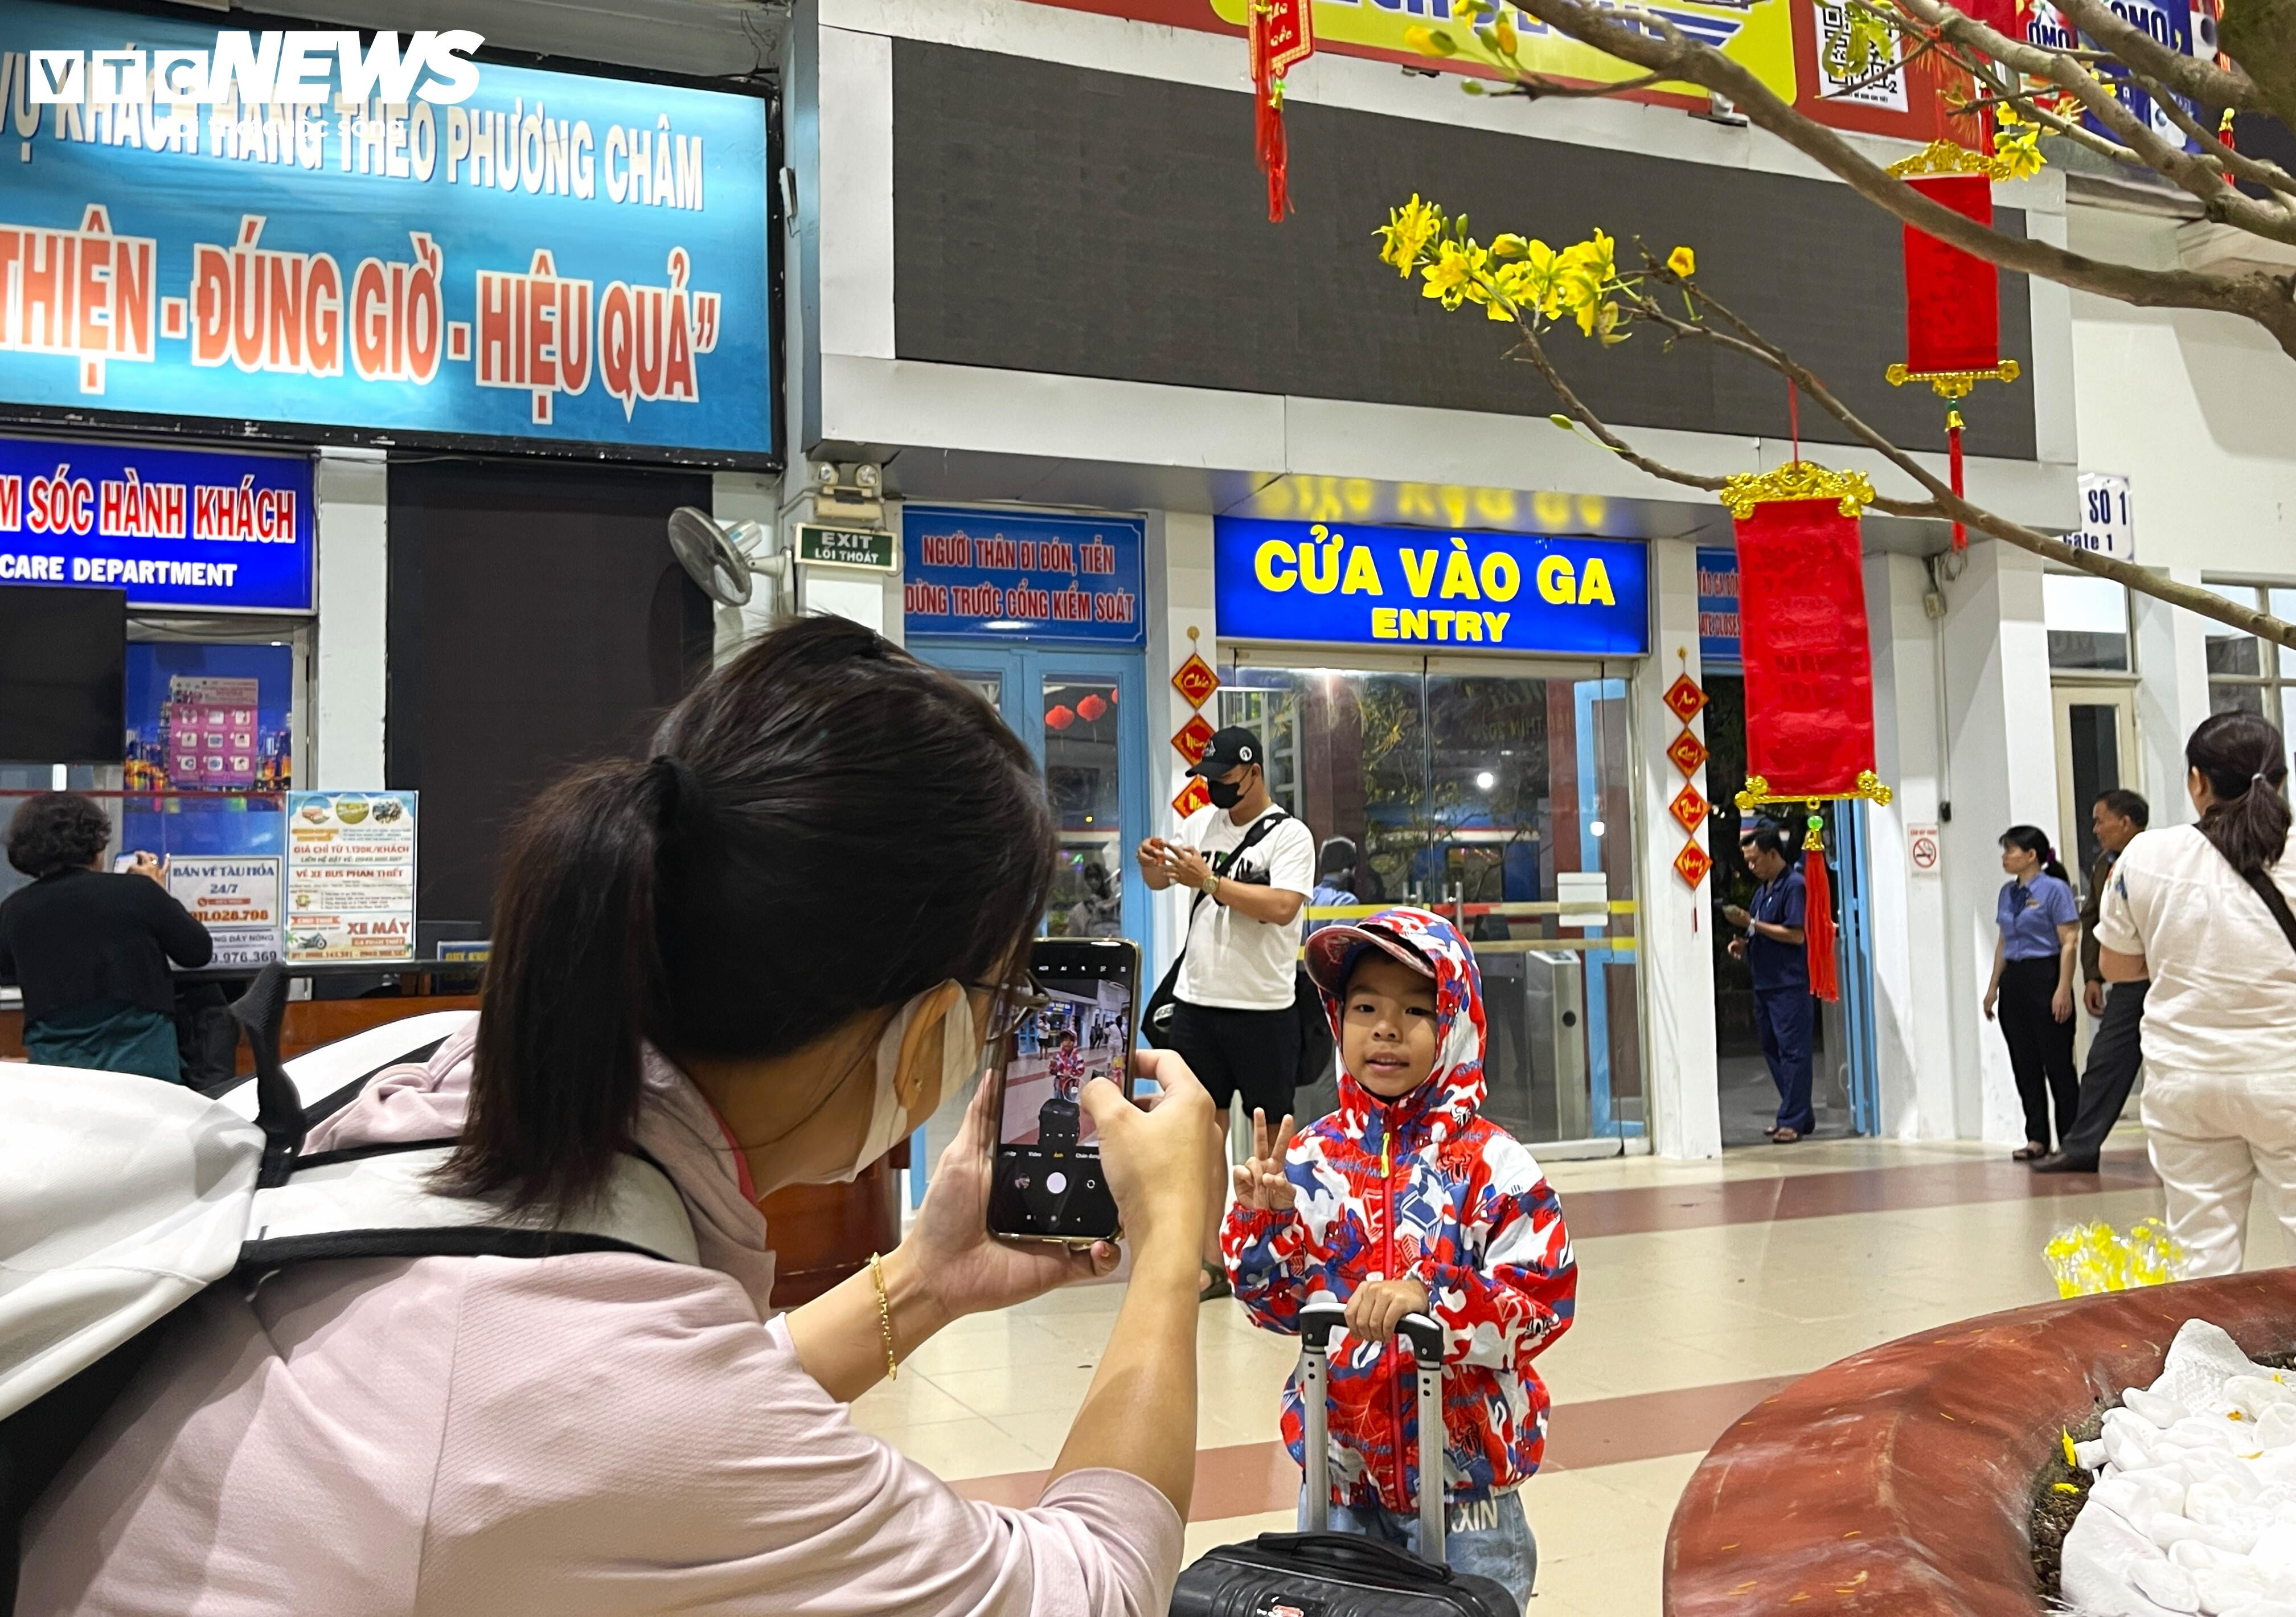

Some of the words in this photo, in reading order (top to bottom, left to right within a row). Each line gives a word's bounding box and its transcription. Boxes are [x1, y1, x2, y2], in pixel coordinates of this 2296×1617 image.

[334, 92, 436, 182] THEO
[447, 97, 596, 200] PHƯƠNG
[604, 113, 703, 211] CHÂM
[190, 214, 343, 378] ĐÚNG
[349, 231, 444, 384] GIỜ
[476, 248, 593, 424] HIỆU
[27, 464, 94, 535] SÓC
[100, 467, 186, 539] HÀNH
[194, 474, 296, 543] KHÁCH
[2119, 490, 2127, 526] 1
[822, 531, 873, 549] EXIT
[839, 550, 879, 564] THOÁT
[922, 530, 971, 568] NGƯỜI
[976, 534, 1016, 570] THÂN
[1020, 541, 1036, 571] ĐI
[1080, 534, 1115, 575] TIỄN
[2106, 533, 2113, 552] 1
[0, 554, 65, 581] CARE
[73, 557, 237, 587] DEPARTMENT
[1254, 524, 1385, 596] CỬA
[1399, 537, 1520, 603] VÀO
[1536, 554, 1616, 605] GA
[951, 582, 1003, 619] TRƯỚC
[1007, 579, 1048, 620] CỔNG
[1053, 580, 1092, 622] KIỂM
[1094, 587, 1134, 623] SOÁT
[1371, 607, 1511, 643] ENTRY
[173, 865, 200, 877] BÁN
[218, 864, 245, 877] TÀU
[210, 883, 238, 895] 24/7
[347, 922, 368, 935] XE
[372, 918, 410, 934] MÁY
